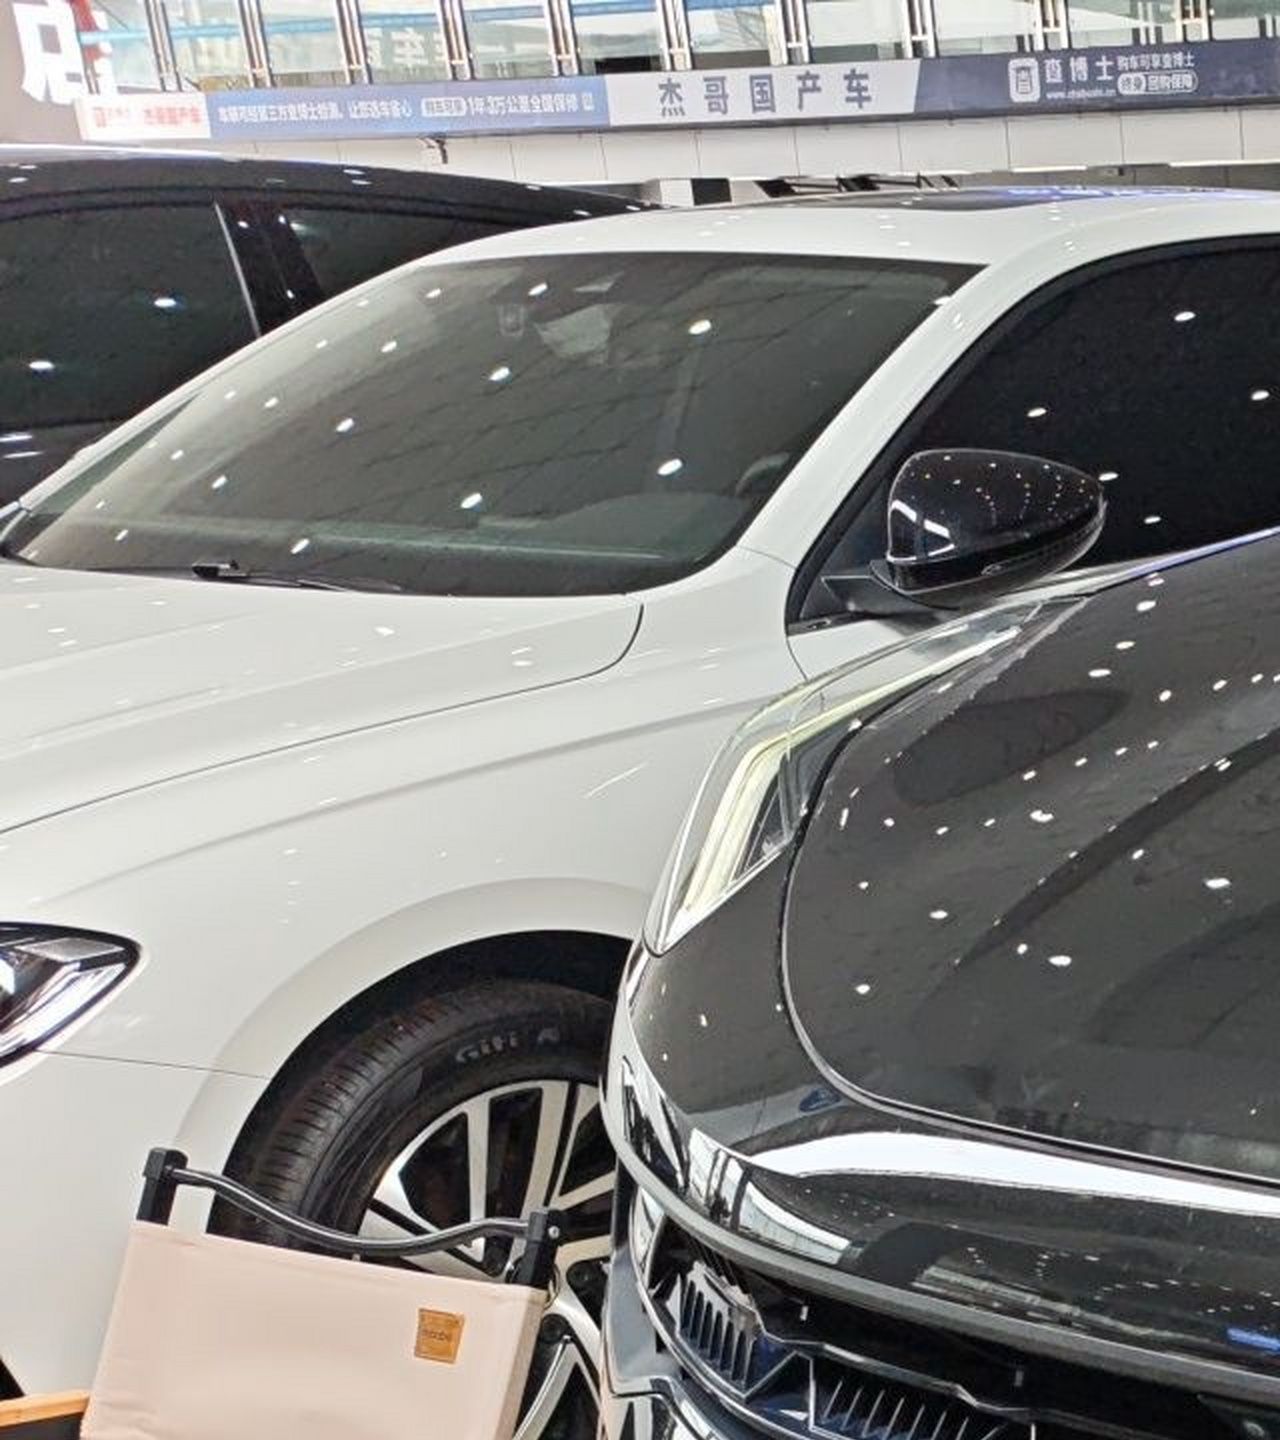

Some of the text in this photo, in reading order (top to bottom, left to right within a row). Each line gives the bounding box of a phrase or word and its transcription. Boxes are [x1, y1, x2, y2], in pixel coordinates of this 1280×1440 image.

[1044, 55, 1114, 83] 查博士
[657, 68, 873, 117] 杰哥国产车
